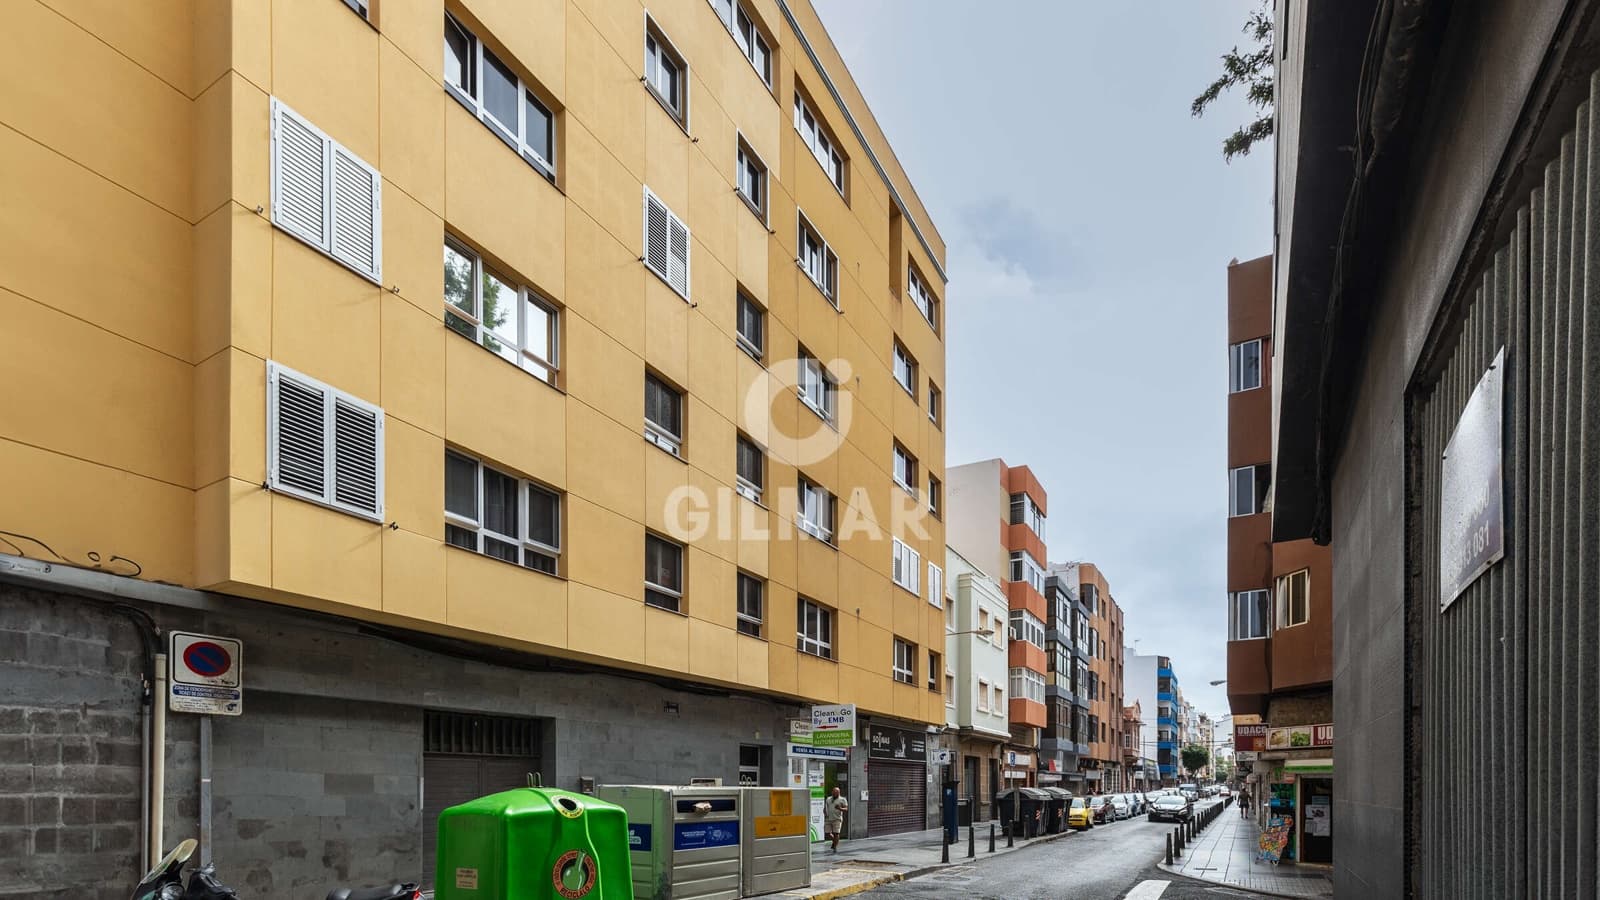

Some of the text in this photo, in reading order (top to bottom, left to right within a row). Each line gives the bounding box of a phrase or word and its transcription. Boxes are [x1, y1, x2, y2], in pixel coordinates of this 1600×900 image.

[1473, 519, 1489, 558] 081
[813, 710, 835, 718] Clean
[840, 708, 852, 716] Go
[813, 716, 845, 726] By EMB
